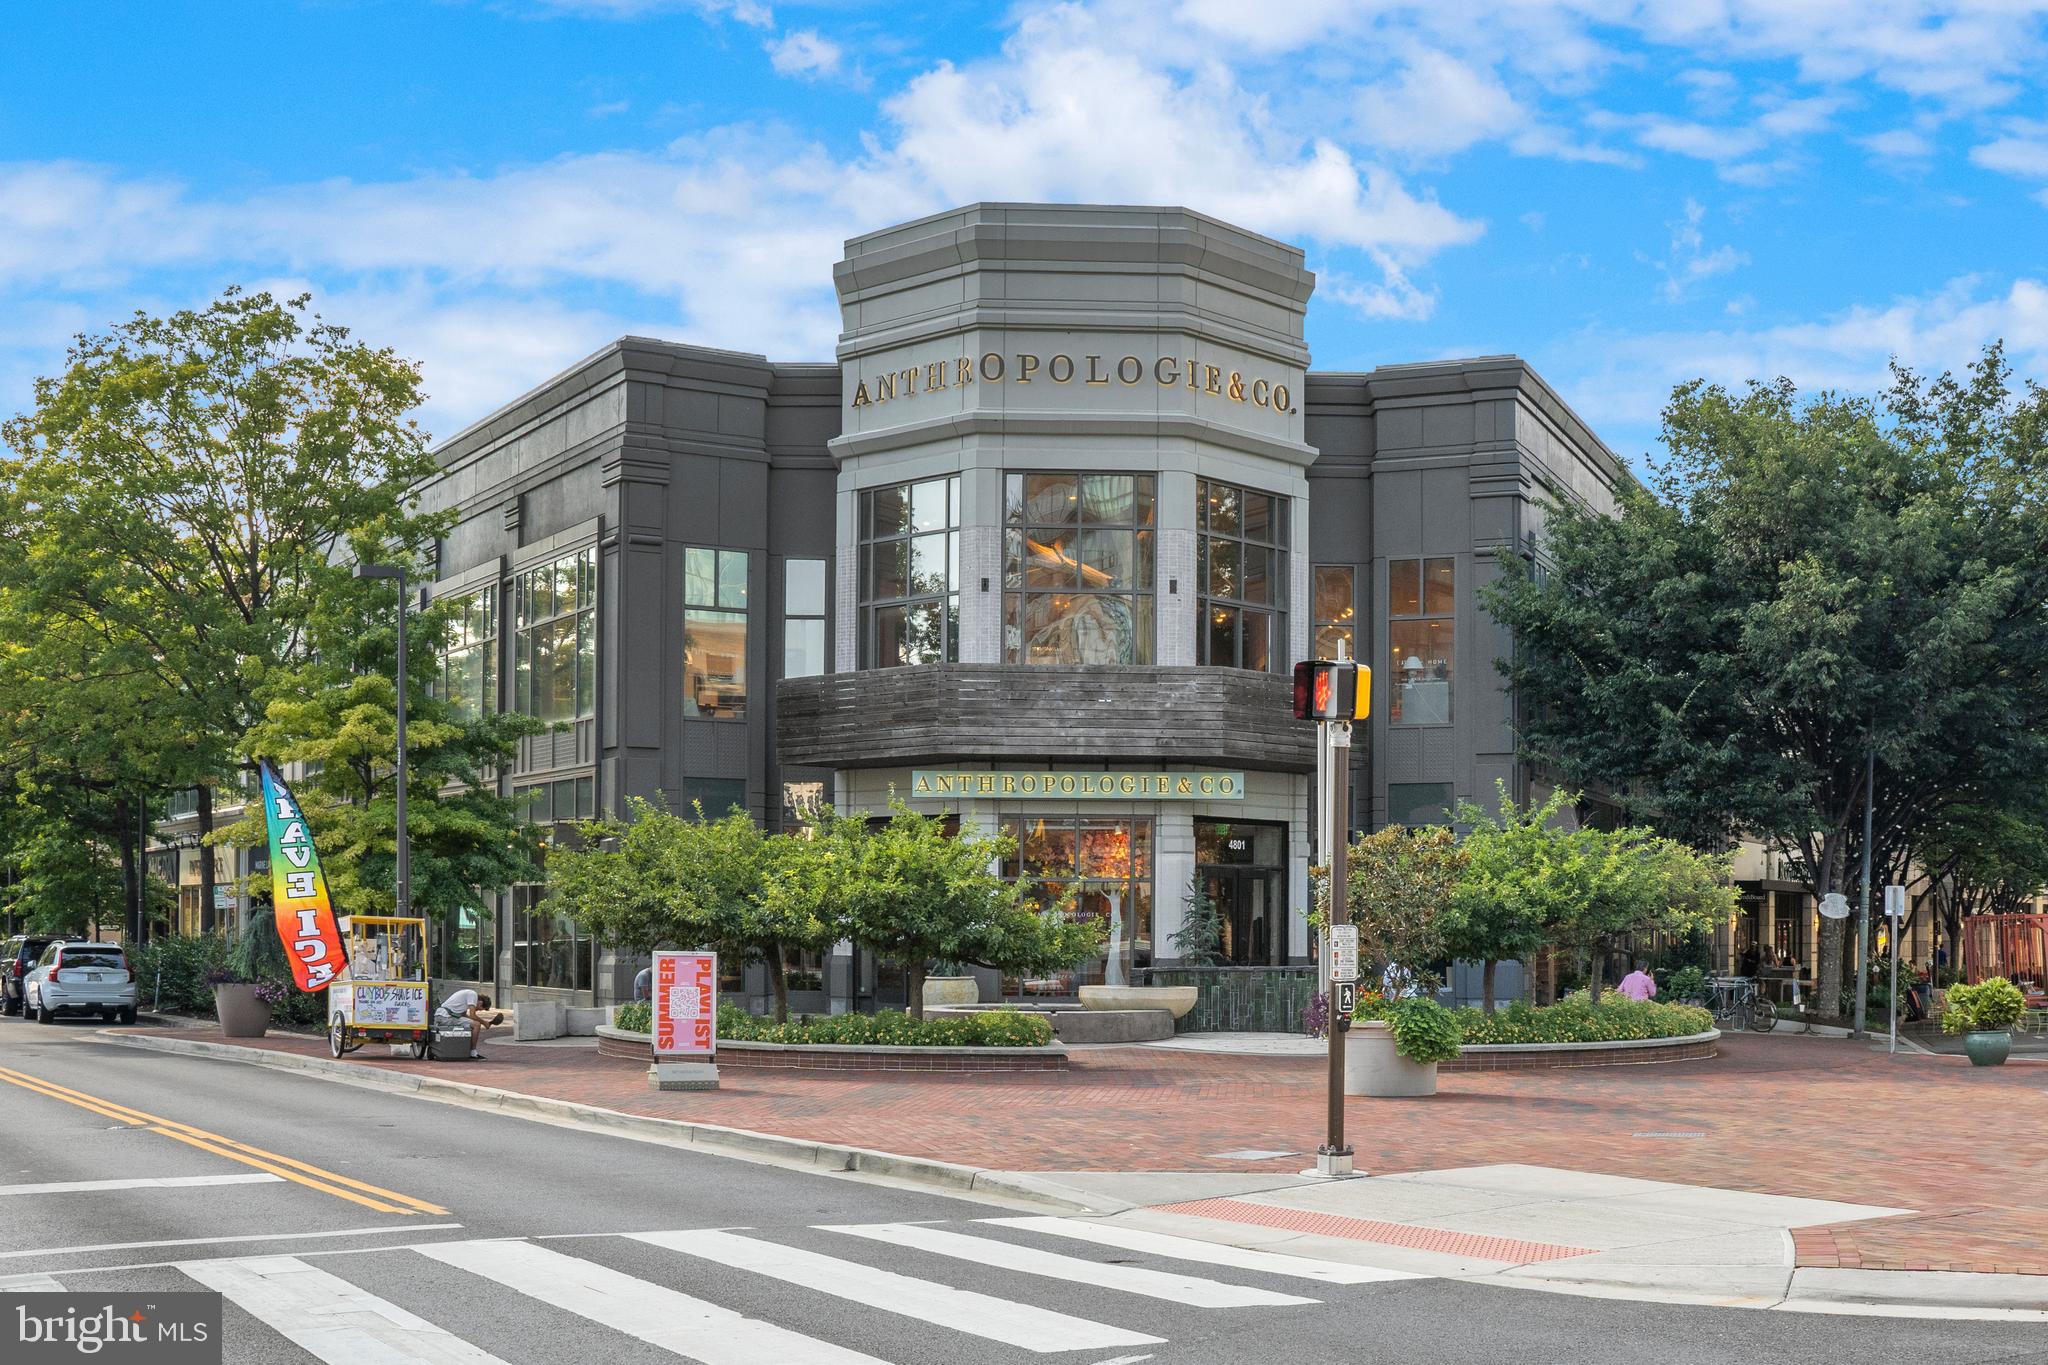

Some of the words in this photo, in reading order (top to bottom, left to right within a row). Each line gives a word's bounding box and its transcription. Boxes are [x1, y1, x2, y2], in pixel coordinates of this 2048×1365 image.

[1228, 839, 1246, 851] 4801
[412, 988, 423, 1000] ICE
[658, 958, 675, 1050] SUMMER
